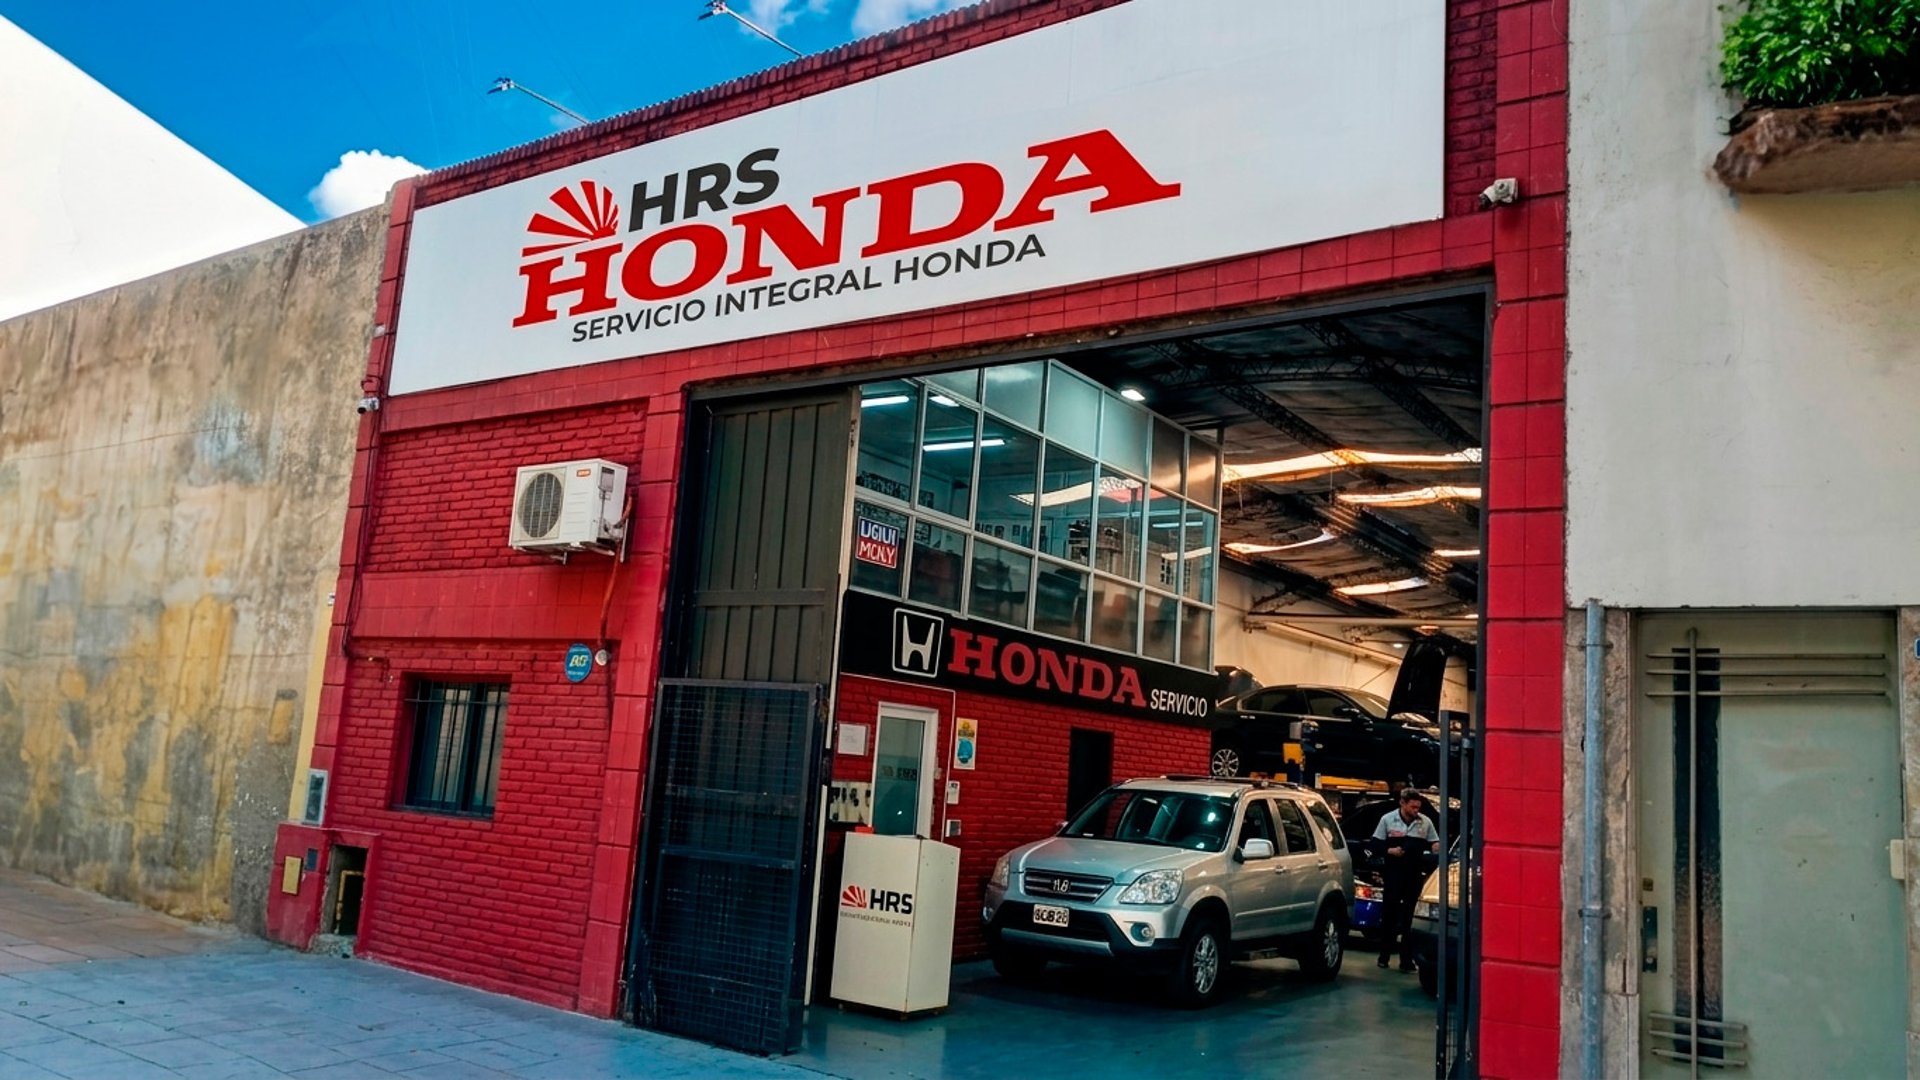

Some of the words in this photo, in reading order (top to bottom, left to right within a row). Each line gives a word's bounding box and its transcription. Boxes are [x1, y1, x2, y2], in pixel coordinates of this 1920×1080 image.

[511, 128, 1182, 328] HONDA
[628, 147, 780, 233] HRS
[572, 299, 706, 343] SERVICIO
[715, 266, 882, 317] INTEGRAL
[894, 233, 1046, 285] HONDA
[948, 628, 1147, 707] HONDA
[1150, 688, 1208, 717] SERVICIO
[869, 888, 913, 915] HRS
